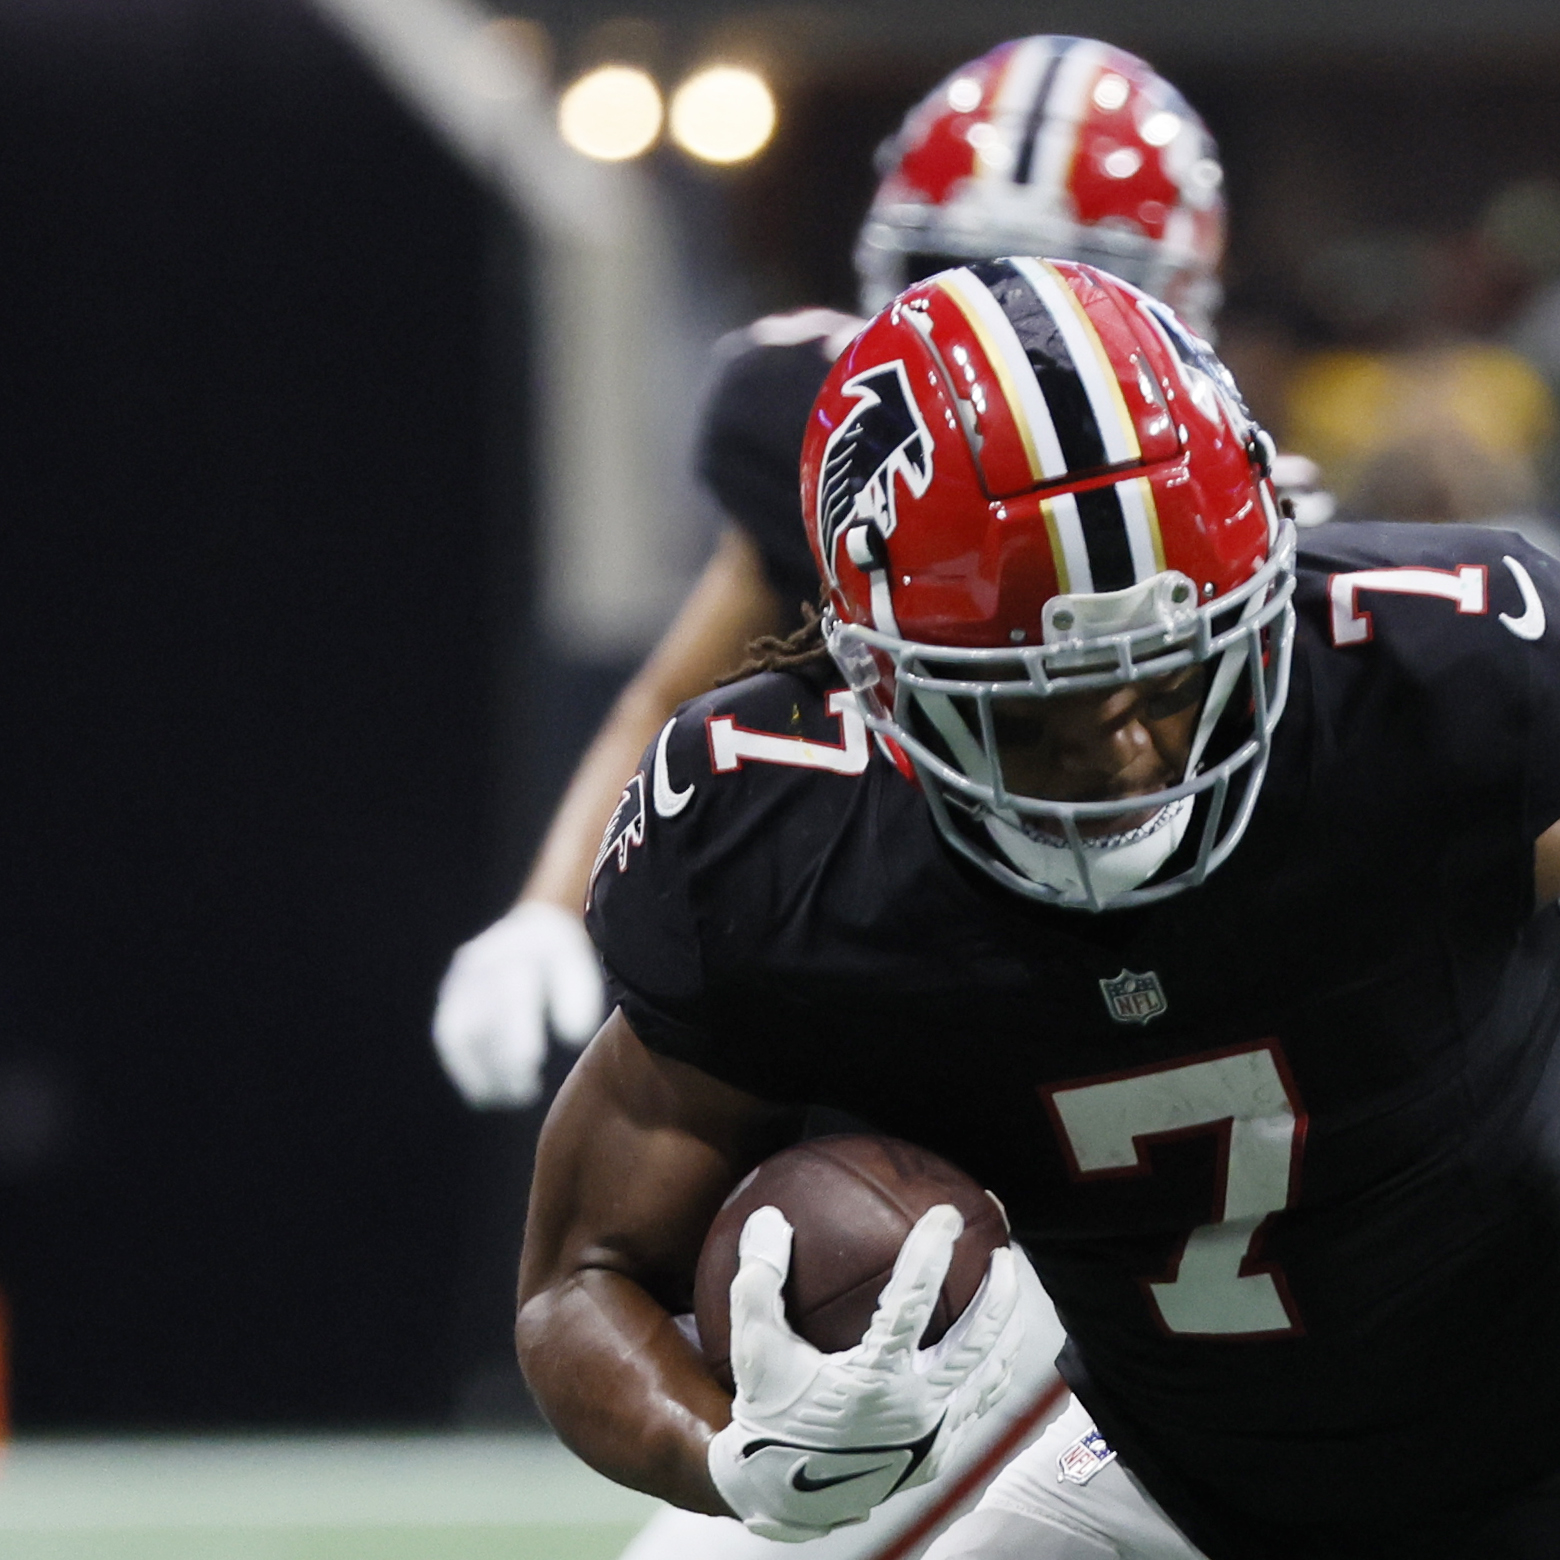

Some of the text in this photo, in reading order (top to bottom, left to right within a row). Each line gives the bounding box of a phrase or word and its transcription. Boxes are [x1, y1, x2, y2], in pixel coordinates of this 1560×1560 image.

[1326, 563, 1490, 648] 7
[704, 688, 873, 777] 7
[1112, 989, 1161, 1016] NFL
[1040, 1036, 1311, 1340] 7
[1063, 1444, 1096, 1476] NFL
